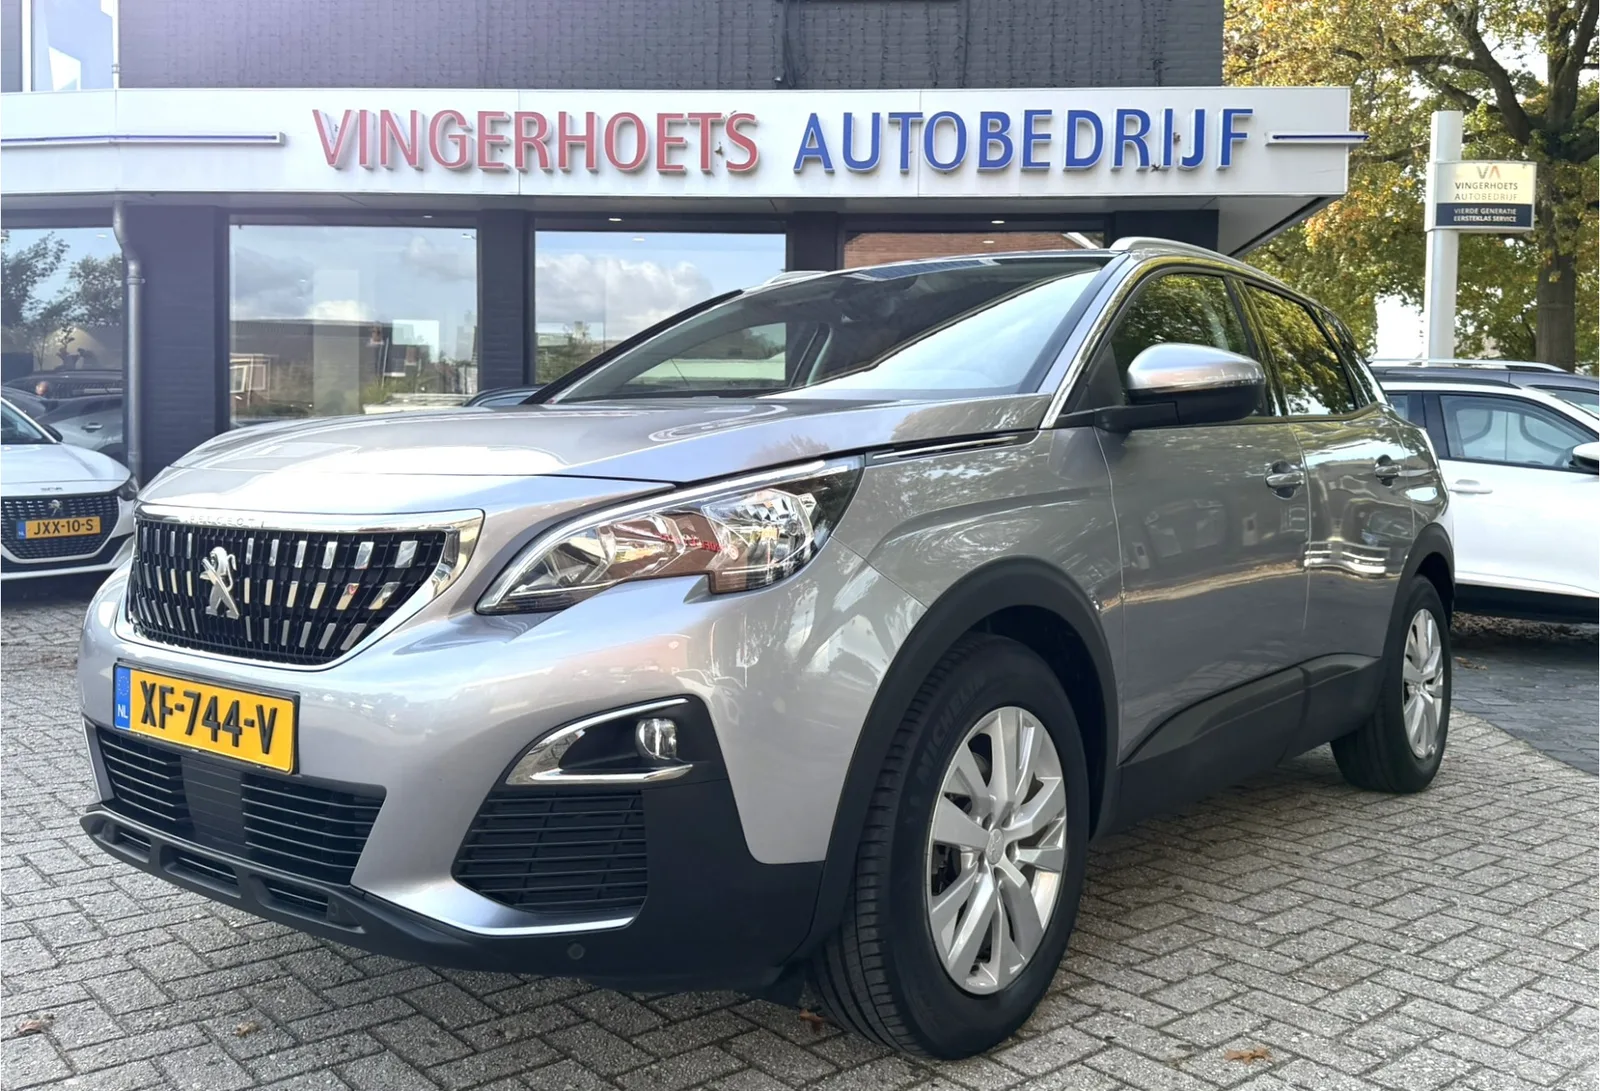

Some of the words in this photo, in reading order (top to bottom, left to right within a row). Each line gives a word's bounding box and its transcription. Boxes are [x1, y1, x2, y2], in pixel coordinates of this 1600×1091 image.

[311, 108, 760, 173] VINGERHOETS
[793, 108, 1254, 173] AUTOBEDRIJF
[1454, 182, 1518, 190] VINGERHOETS
[1454, 192, 1518, 201] AUTOBEDRIJF
[33, 518, 94, 535] JXX-10-S
[117, 703, 129, 719] NL
[140, 680, 278, 755] XF-744-V
